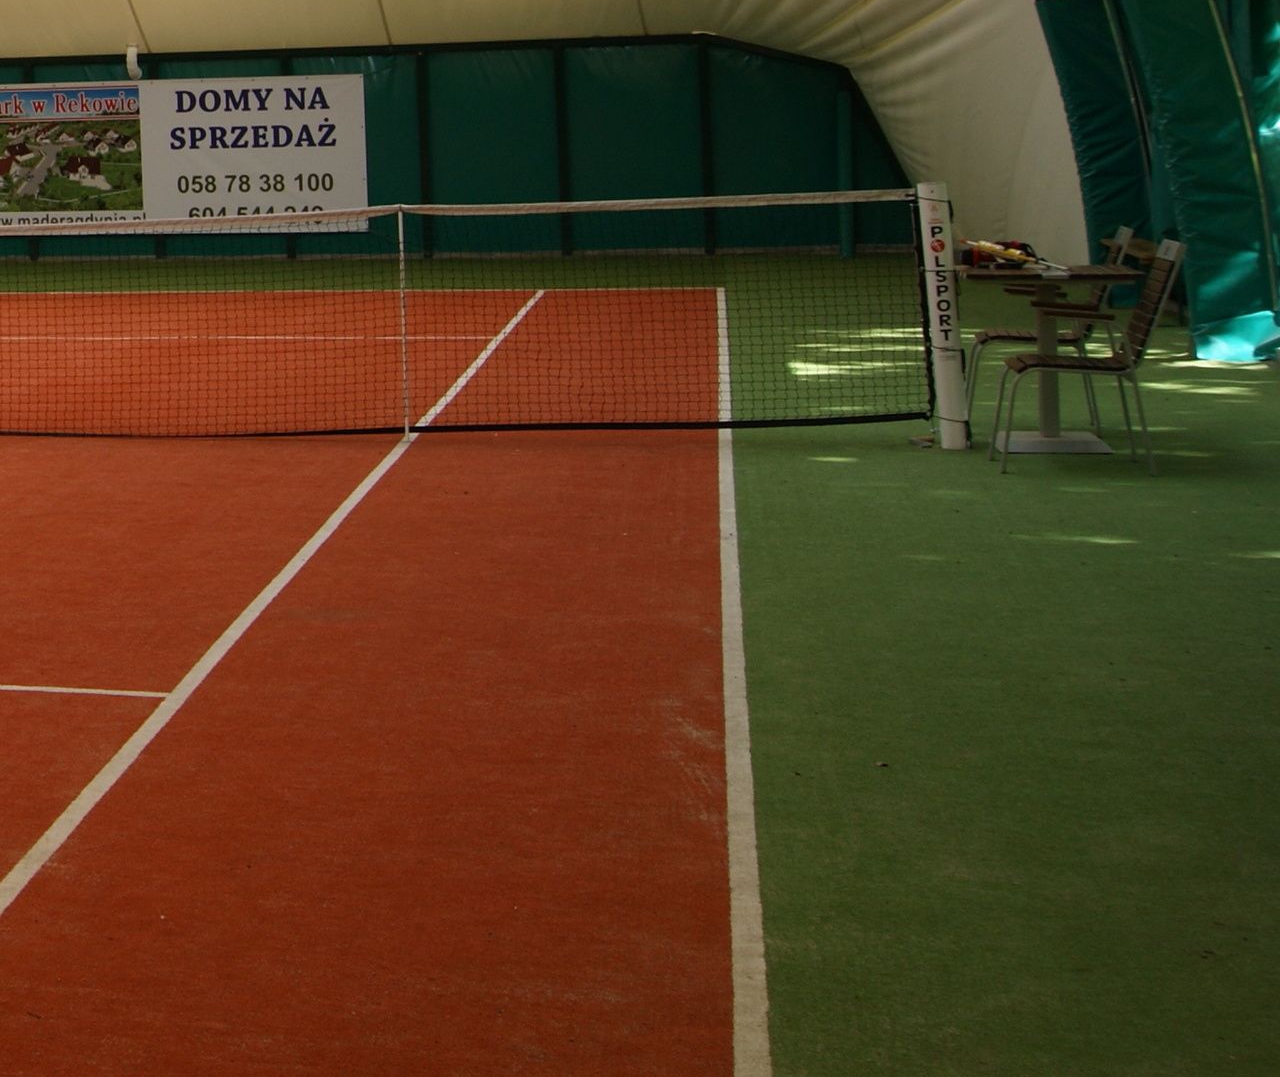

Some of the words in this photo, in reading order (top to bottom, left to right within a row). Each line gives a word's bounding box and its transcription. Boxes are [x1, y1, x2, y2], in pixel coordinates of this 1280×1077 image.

[32, 100, 47, 114] w
[53, 91, 138, 113] Rekowie
[175, 89, 273, 113] DOMY
[284, 87, 330, 110] NA
[170, 118, 337, 150] SPRZEDAŻ
[177, 175, 216, 193] 058
[225, 175, 251, 192] 78
[259, 174, 285, 192] 38
[294, 173, 334, 191] 100
